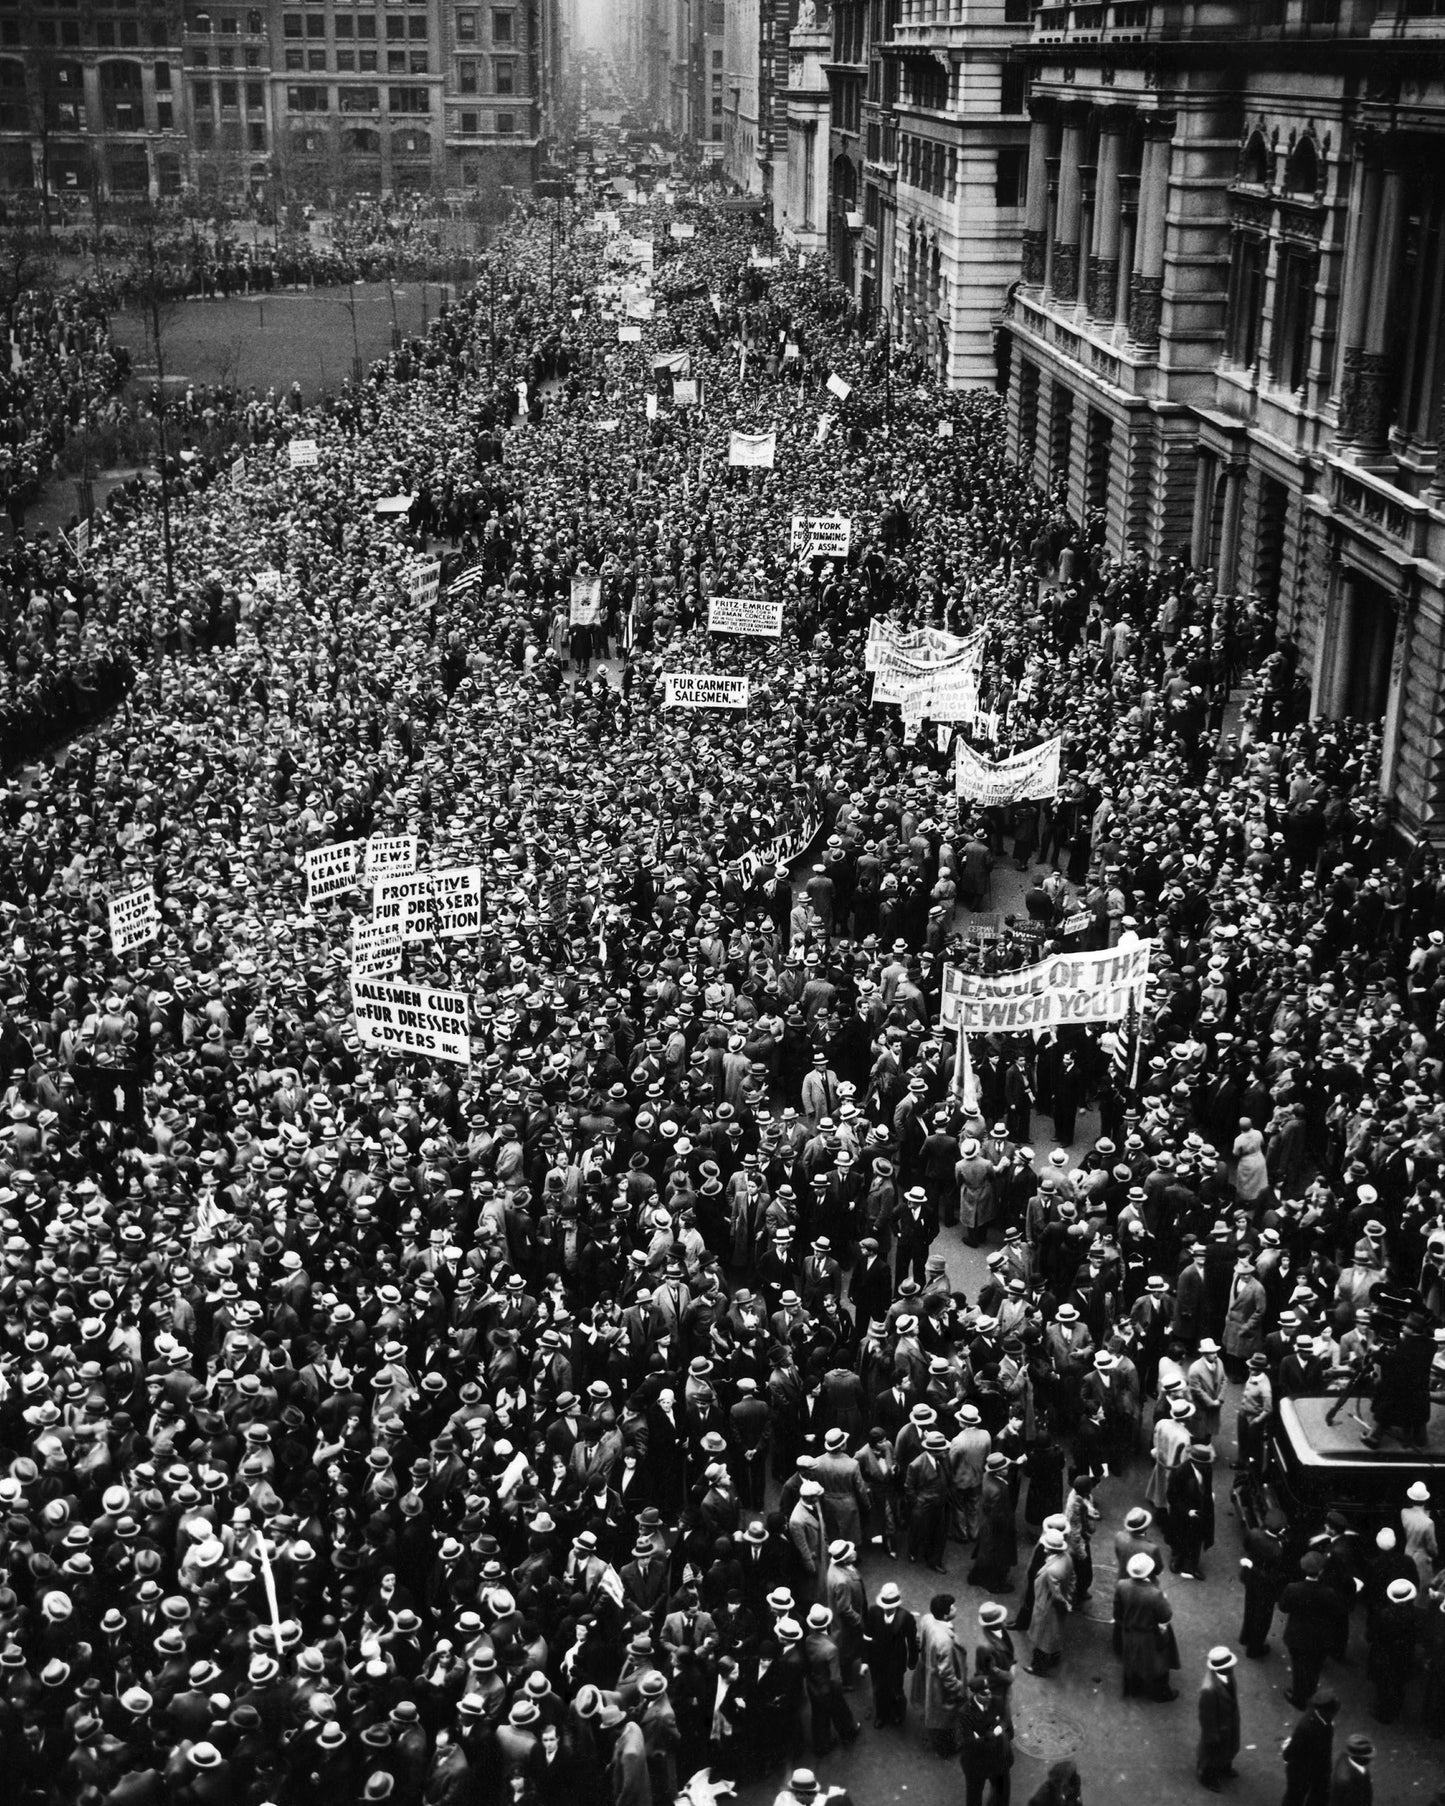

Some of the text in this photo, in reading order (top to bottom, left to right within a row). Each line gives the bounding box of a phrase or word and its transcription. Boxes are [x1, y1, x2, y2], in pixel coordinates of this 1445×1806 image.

[799, 521, 841, 530] NW YORK
[713, 610, 776, 620] GERMAN CONCERN
[697, 680, 743, 692] GARMENT
[372, 840, 411, 850] HITLER
[310, 847, 351, 866] HITLER
[372, 850, 410, 863] JEWS
[311, 861, 350, 881] CEASE
[311, 874, 356, 897] BARBARISM
[382, 875, 470, 900] PROTECTIVE
[114, 893, 150, 914] HITLER
[376, 892, 479, 919] FUR DRESSERS
[119, 906, 148, 923] STOP
[121, 926, 151, 947] JEWS
[359, 923, 399, 939] HITLER
[355, 946, 401, 963] ARE GERMAN
[945, 966, 1043, 998] LEAGUE
[1050, 961, 1085, 988] OF
[354, 982, 465, 1014] SALESMEN CLUB
[366, 1003, 392, 1023] FUR
[398, 1009, 469, 1037] DRESSERS
[944, 996, 1050, 1027] JEWISH
